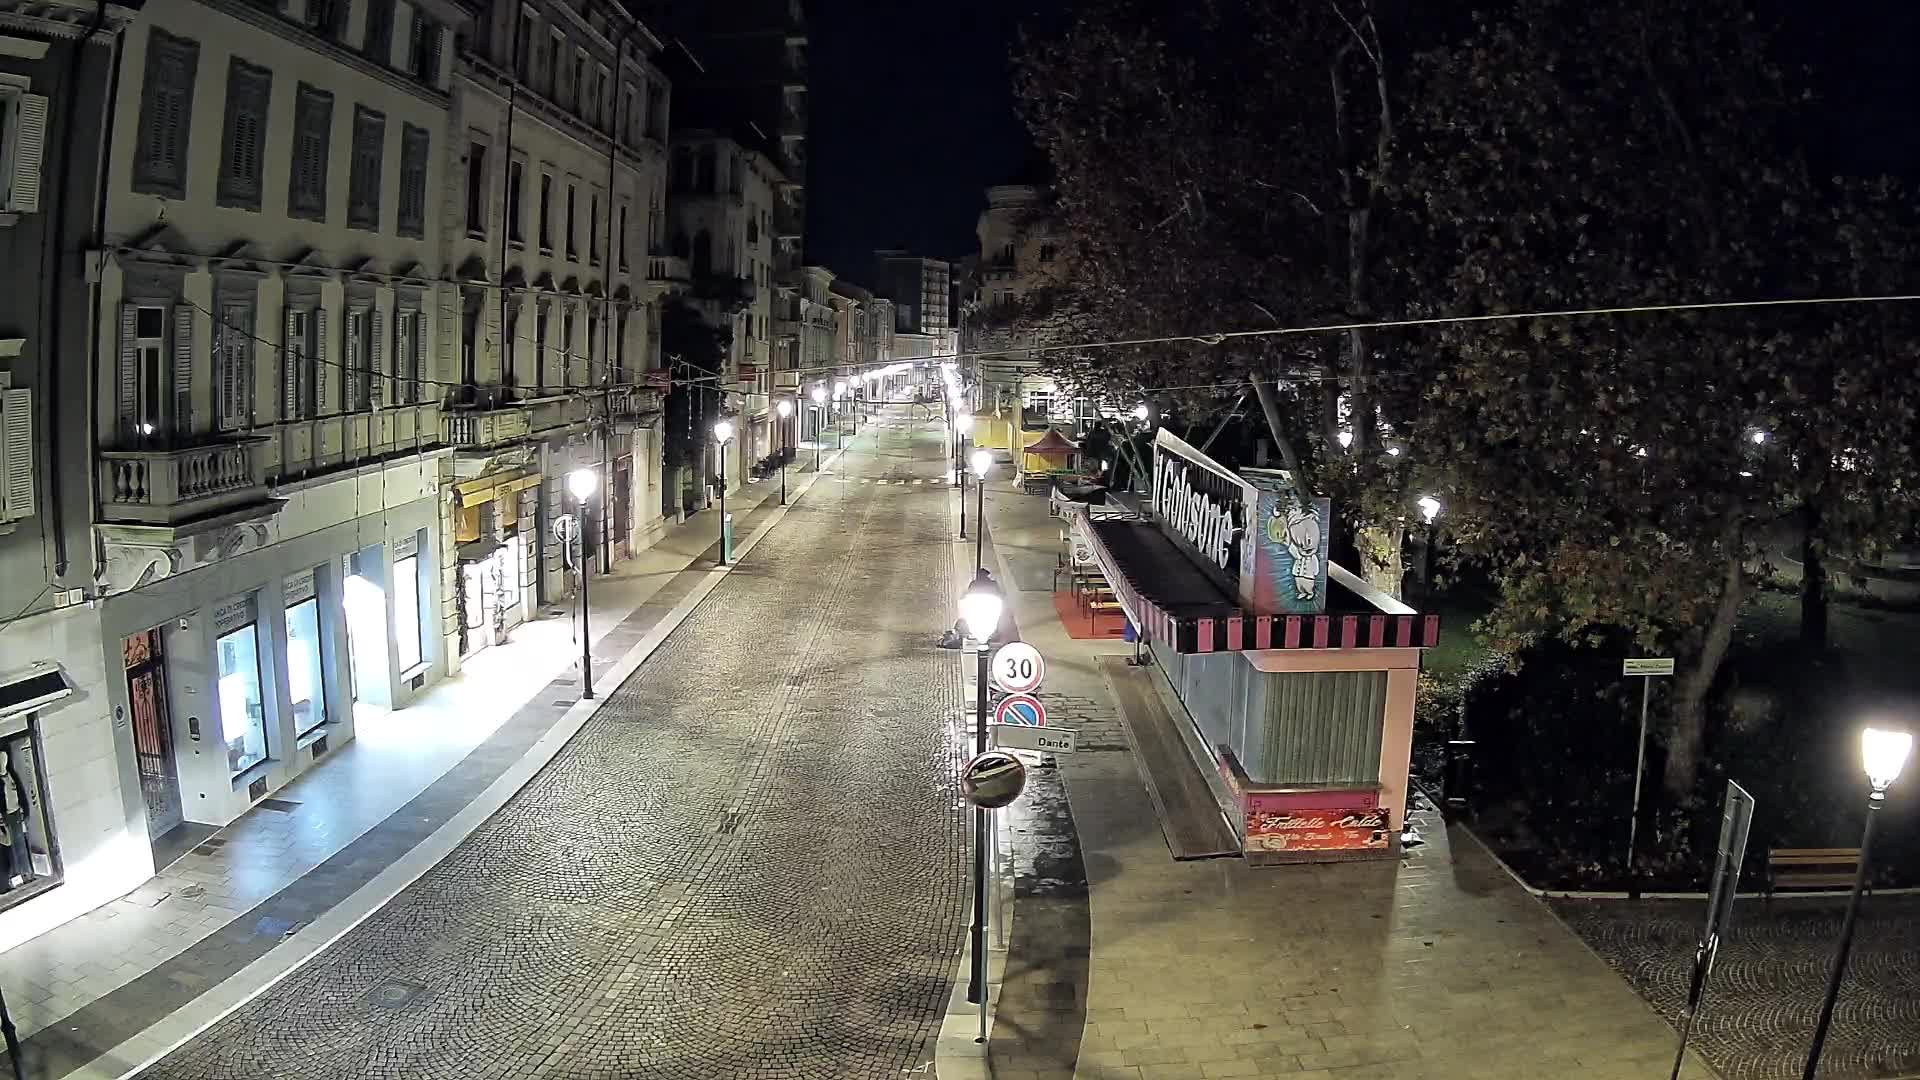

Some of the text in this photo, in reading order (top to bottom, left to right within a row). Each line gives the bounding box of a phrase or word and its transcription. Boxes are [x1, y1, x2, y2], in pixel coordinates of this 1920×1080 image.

[1162, 458, 1233, 569] Golosone
[1006, 658, 1032, 679] 30
[1038, 737, 1070, 749] Dante
